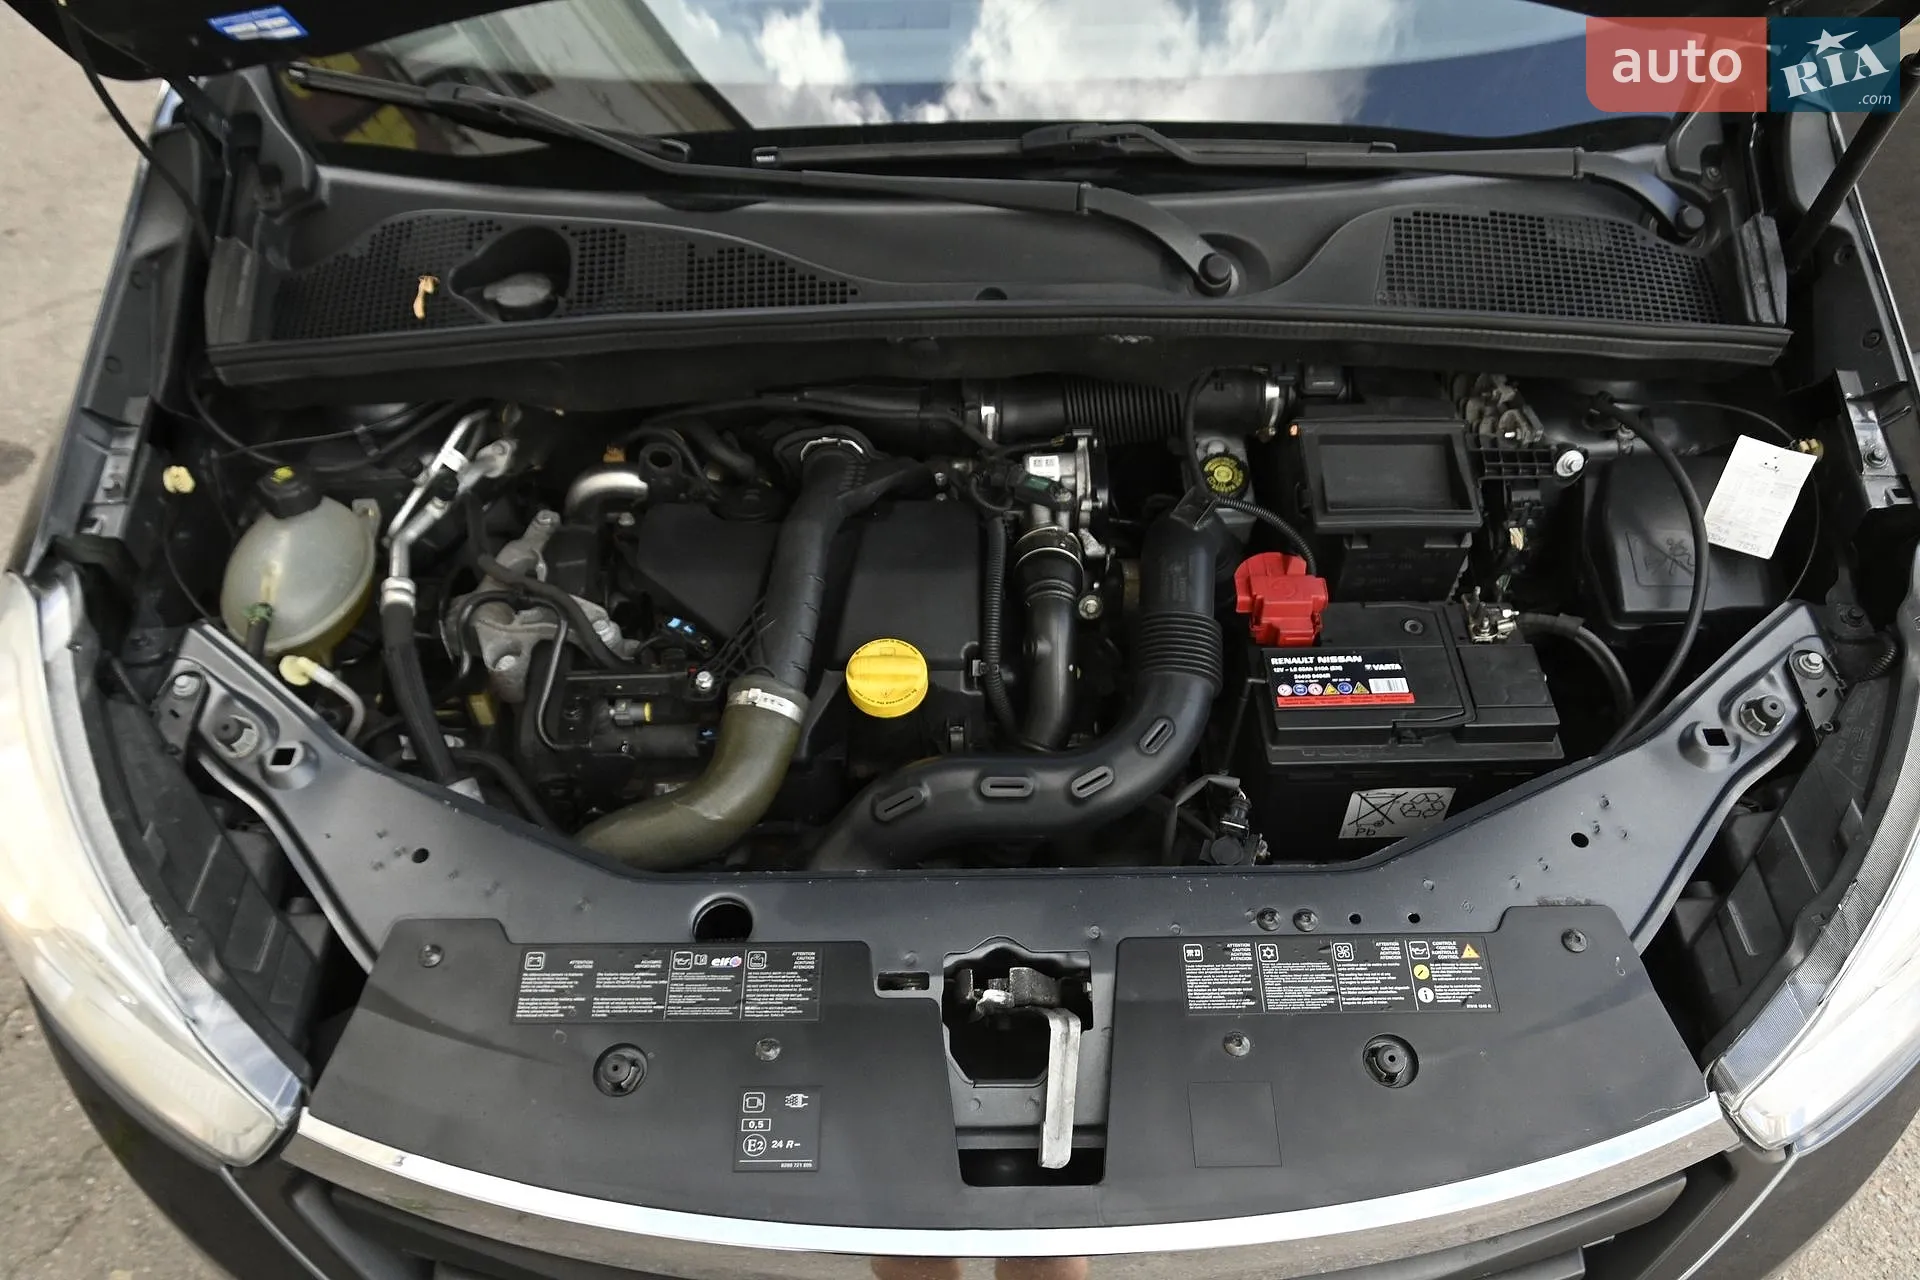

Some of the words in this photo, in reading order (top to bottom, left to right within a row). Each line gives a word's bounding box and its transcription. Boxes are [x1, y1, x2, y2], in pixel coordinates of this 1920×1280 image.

[1271, 656, 1314, 665] RENAULT
[1317, 655, 1362, 663] NISSAN
[1372, 663, 1402, 671] VARTA
[1355, 827, 1376, 836] Pb
[748, 1121, 764, 1129] 0,5
[747, 1139, 764, 1152] E2
[771, 1140, 783, 1148] 24
